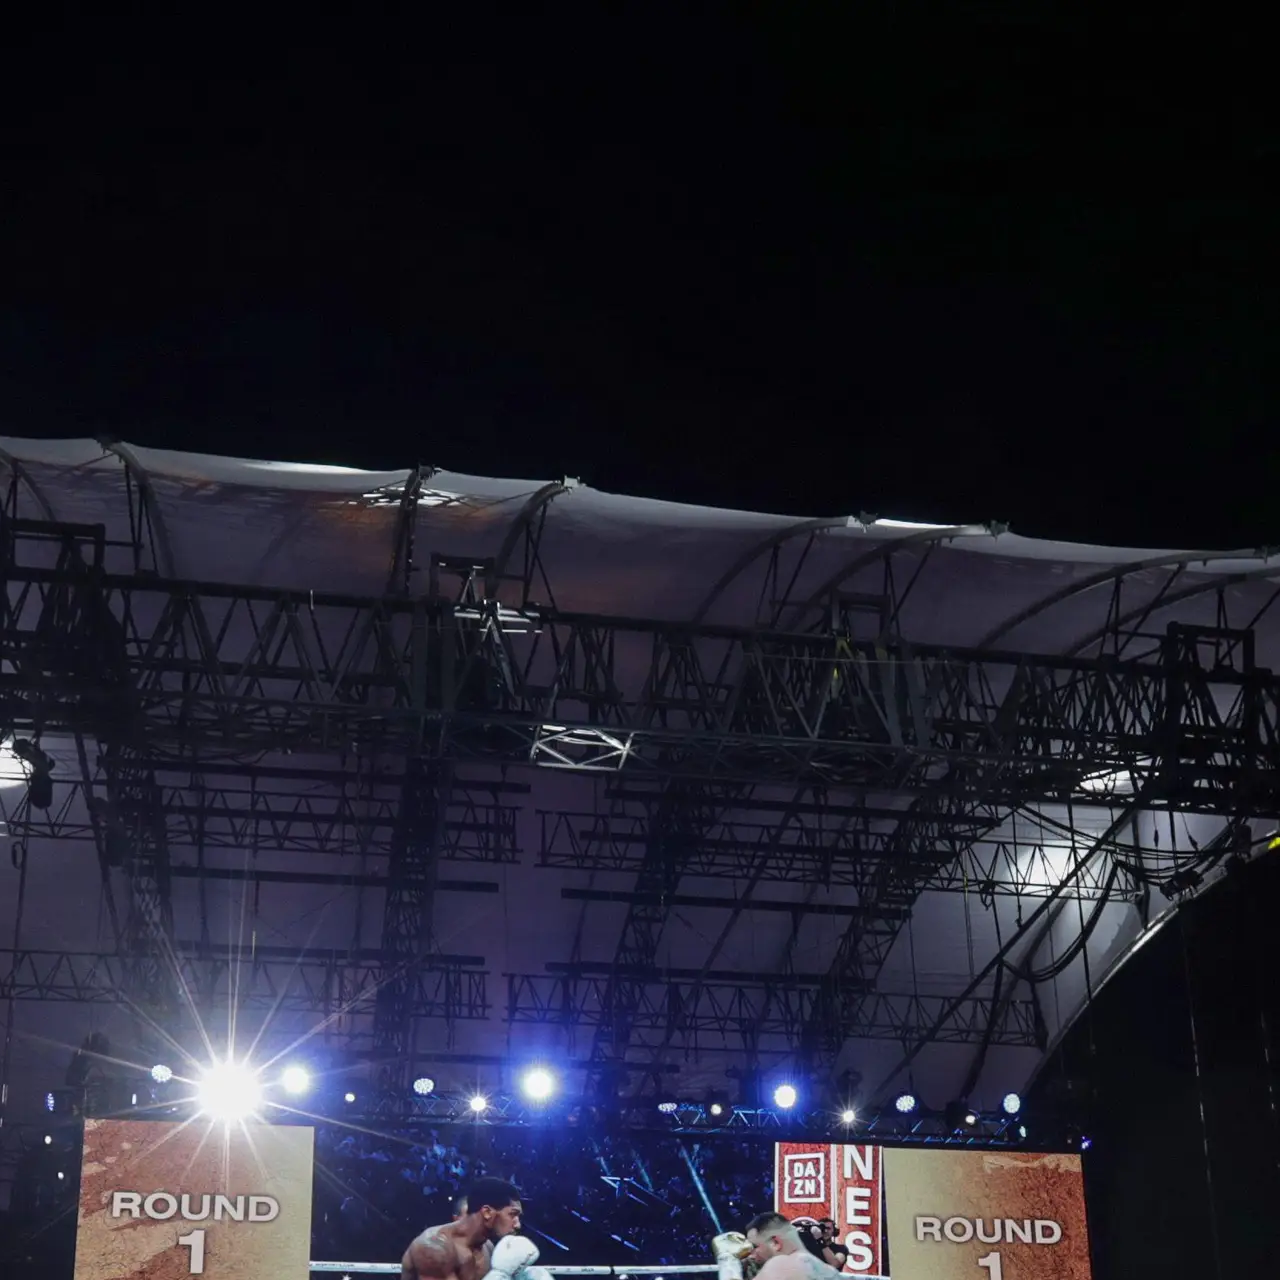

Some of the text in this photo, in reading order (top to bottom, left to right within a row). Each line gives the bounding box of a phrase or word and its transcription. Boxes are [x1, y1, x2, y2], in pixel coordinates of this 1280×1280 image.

[111, 1191, 280, 1222] ROUND
[915, 1216, 1062, 1245] ROUND
[178, 1230, 206, 1273] 1
